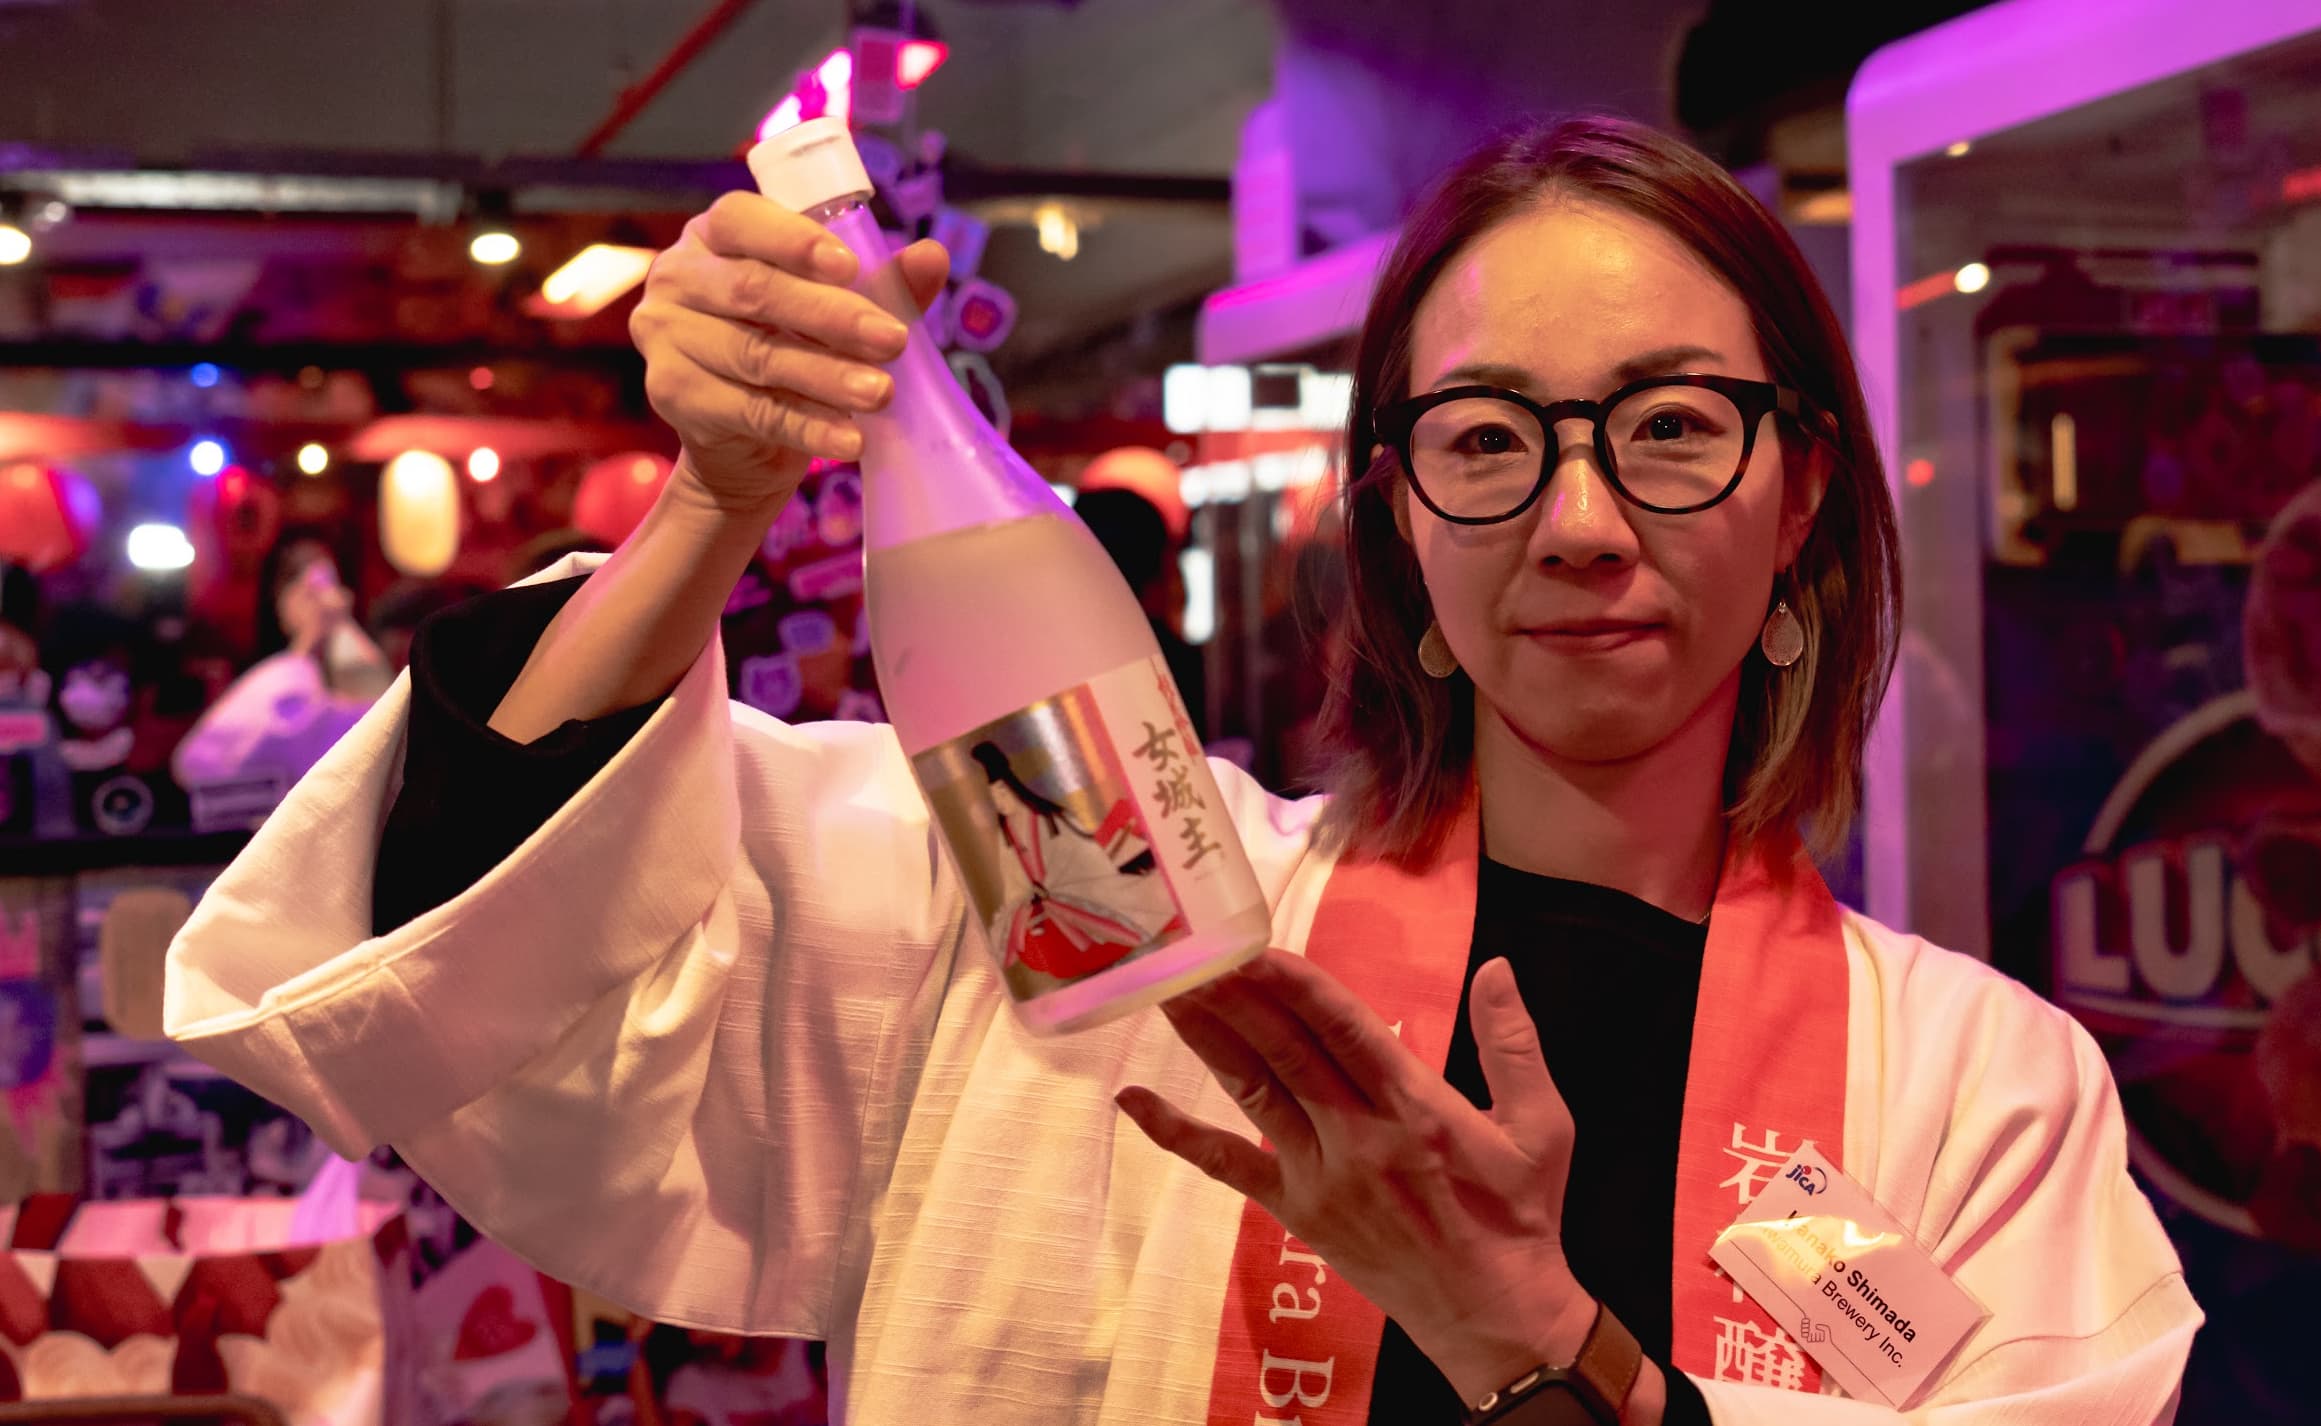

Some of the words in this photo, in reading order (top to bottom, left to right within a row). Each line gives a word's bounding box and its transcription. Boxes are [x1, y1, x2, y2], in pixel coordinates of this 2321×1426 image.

[1132, 721, 1221, 870] 女城主
[1821, 1280, 1881, 1341] Brewery
[1878, 1336, 1904, 1368] Inc.
[1846, 1269, 1917, 1343] Shimada
